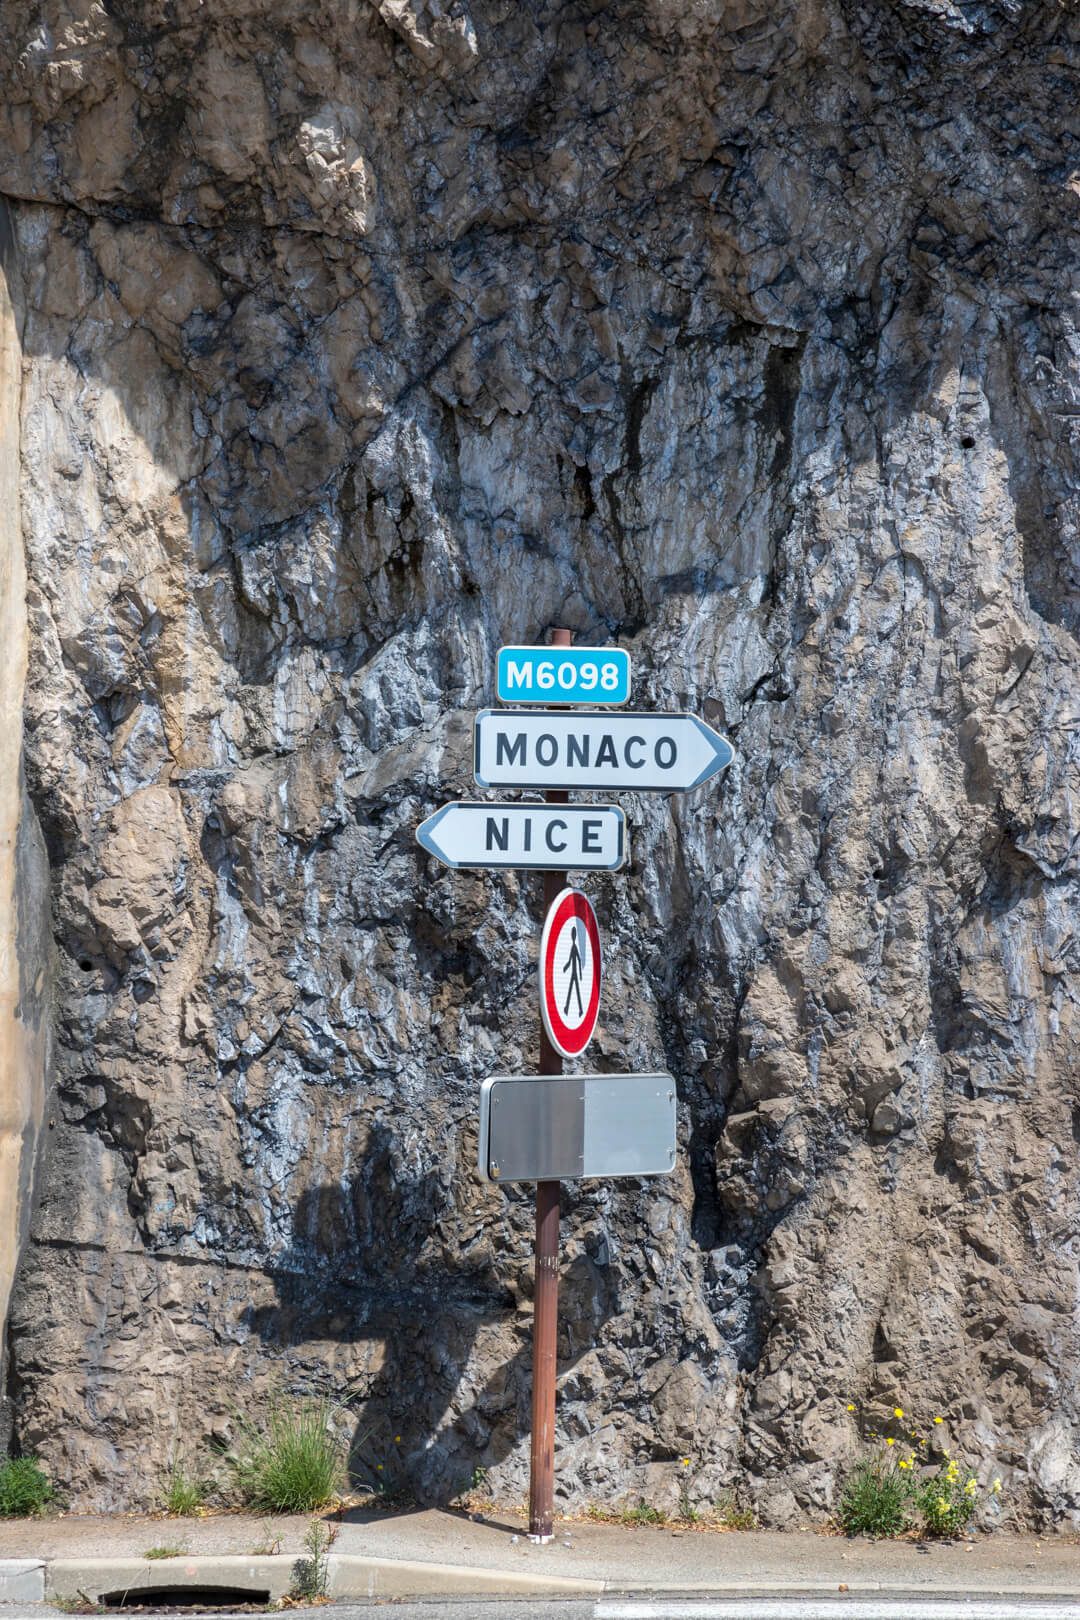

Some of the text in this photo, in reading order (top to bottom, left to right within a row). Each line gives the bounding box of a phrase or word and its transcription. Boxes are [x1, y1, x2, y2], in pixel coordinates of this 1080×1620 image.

[507, 661, 619, 690] M6098
[496, 733, 678, 769] MONACO
[485, 817, 603, 853] NICE
